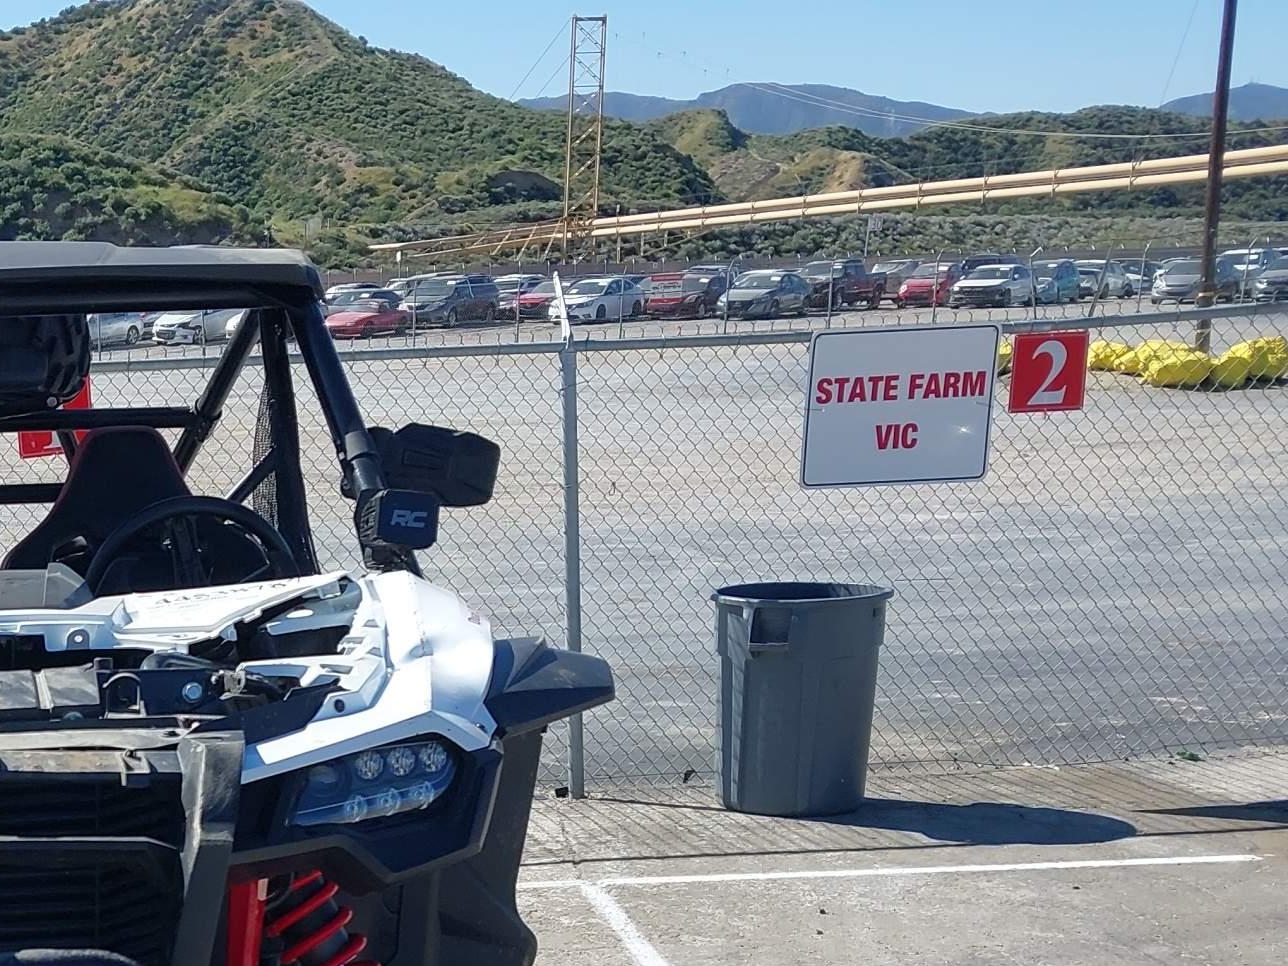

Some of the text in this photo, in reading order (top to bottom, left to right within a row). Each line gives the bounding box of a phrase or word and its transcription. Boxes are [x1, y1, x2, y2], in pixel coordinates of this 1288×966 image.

[815, 370, 987, 404] STATE FARM
[1025, 339, 1069, 406] 2
[875, 422, 919, 450] VIC
[391, 509, 428, 528] RC
